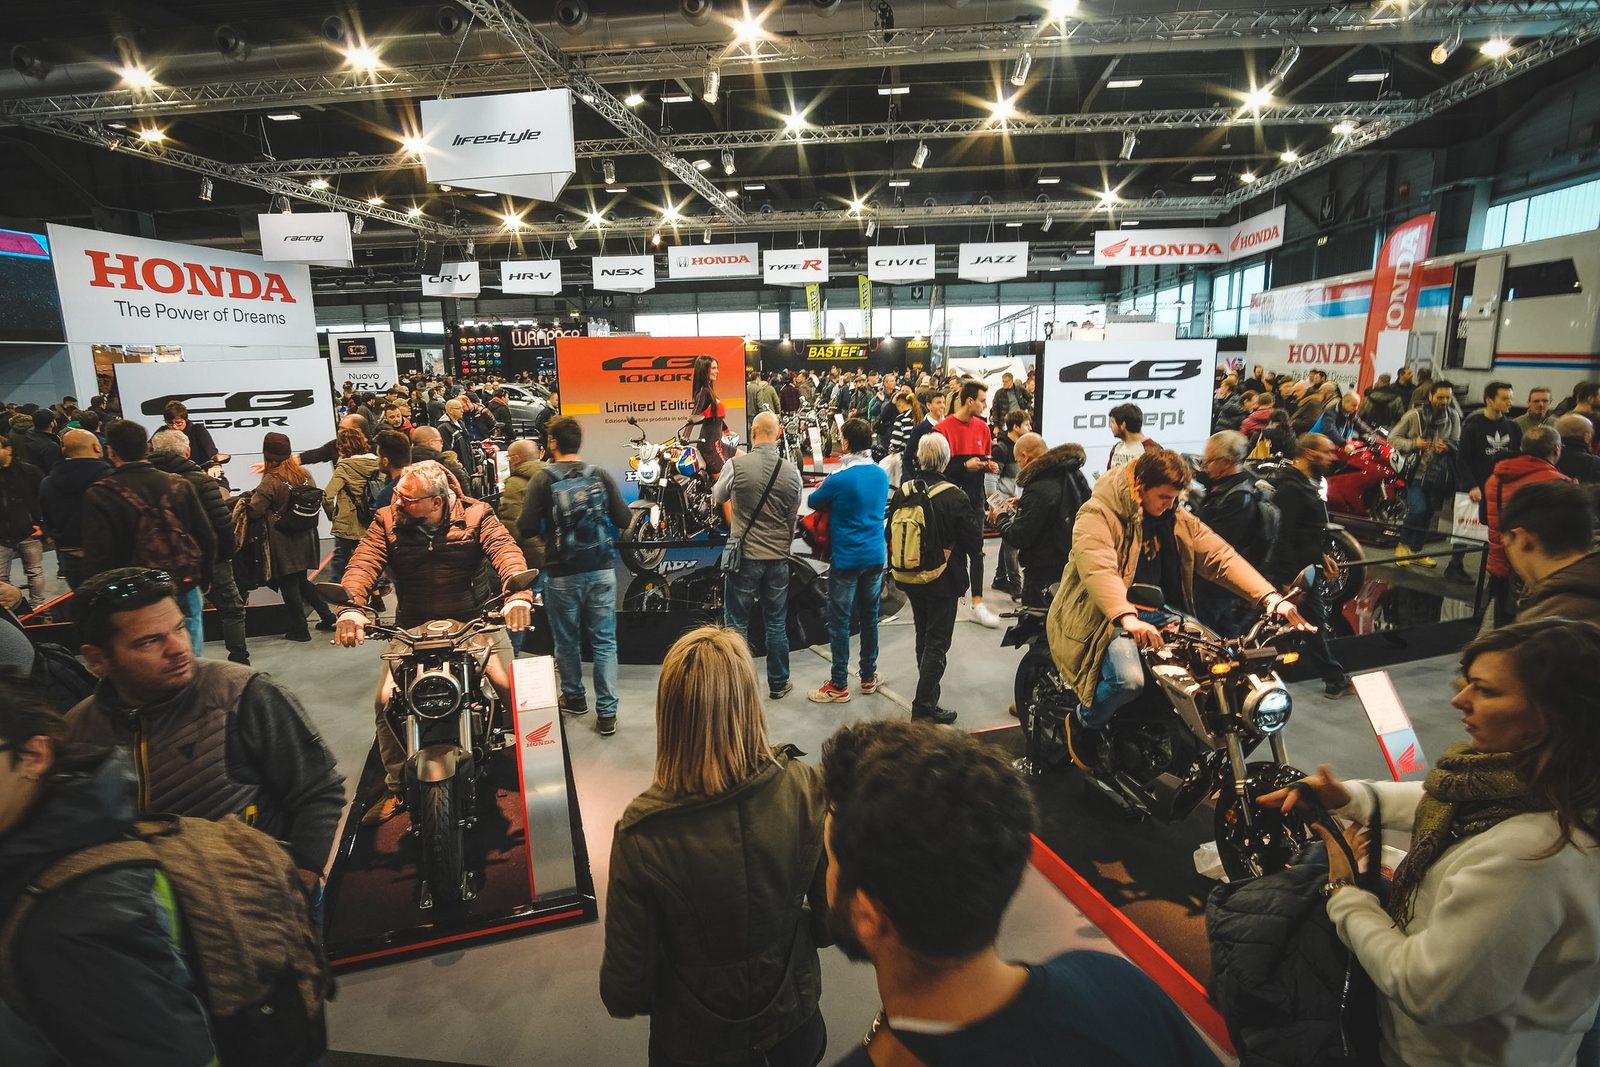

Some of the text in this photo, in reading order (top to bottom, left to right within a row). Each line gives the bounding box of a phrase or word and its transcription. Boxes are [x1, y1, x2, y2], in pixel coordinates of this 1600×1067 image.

[451, 129, 542, 147] lifestyle
[284, 234, 324, 243] racing
[1240, 224, 1280, 248] HONDA
[1130, 242, 1225, 257] HONDA
[692, 254, 751, 266] HONDA
[769, 259, 822, 271] TYPE R
[875, 257, 928, 268] CIVIC
[969, 254, 1017, 265] JAZZ
[84, 249, 297, 303] HONDA
[428, 273, 471, 284] CR-V
[508, 271, 553, 281] HR-V
[600, 267, 645, 277] NSX
[1384, 225, 1421, 331] ONDA
[114, 300, 286, 325] The Power of Dreams
[1287, 343, 1362, 364] HONDA
[1059, 359, 1203, 382] CB
[619, 373, 693, 383] 1000R
[352, 382, 387, 391] R-V
[1084, 388, 1177, 401] 650R
[141, 389, 315, 416] CB
[605, 399, 695, 413] Limited Editio
[191, 416, 290, 429] 50R
[1073, 409, 1185, 431] coept
